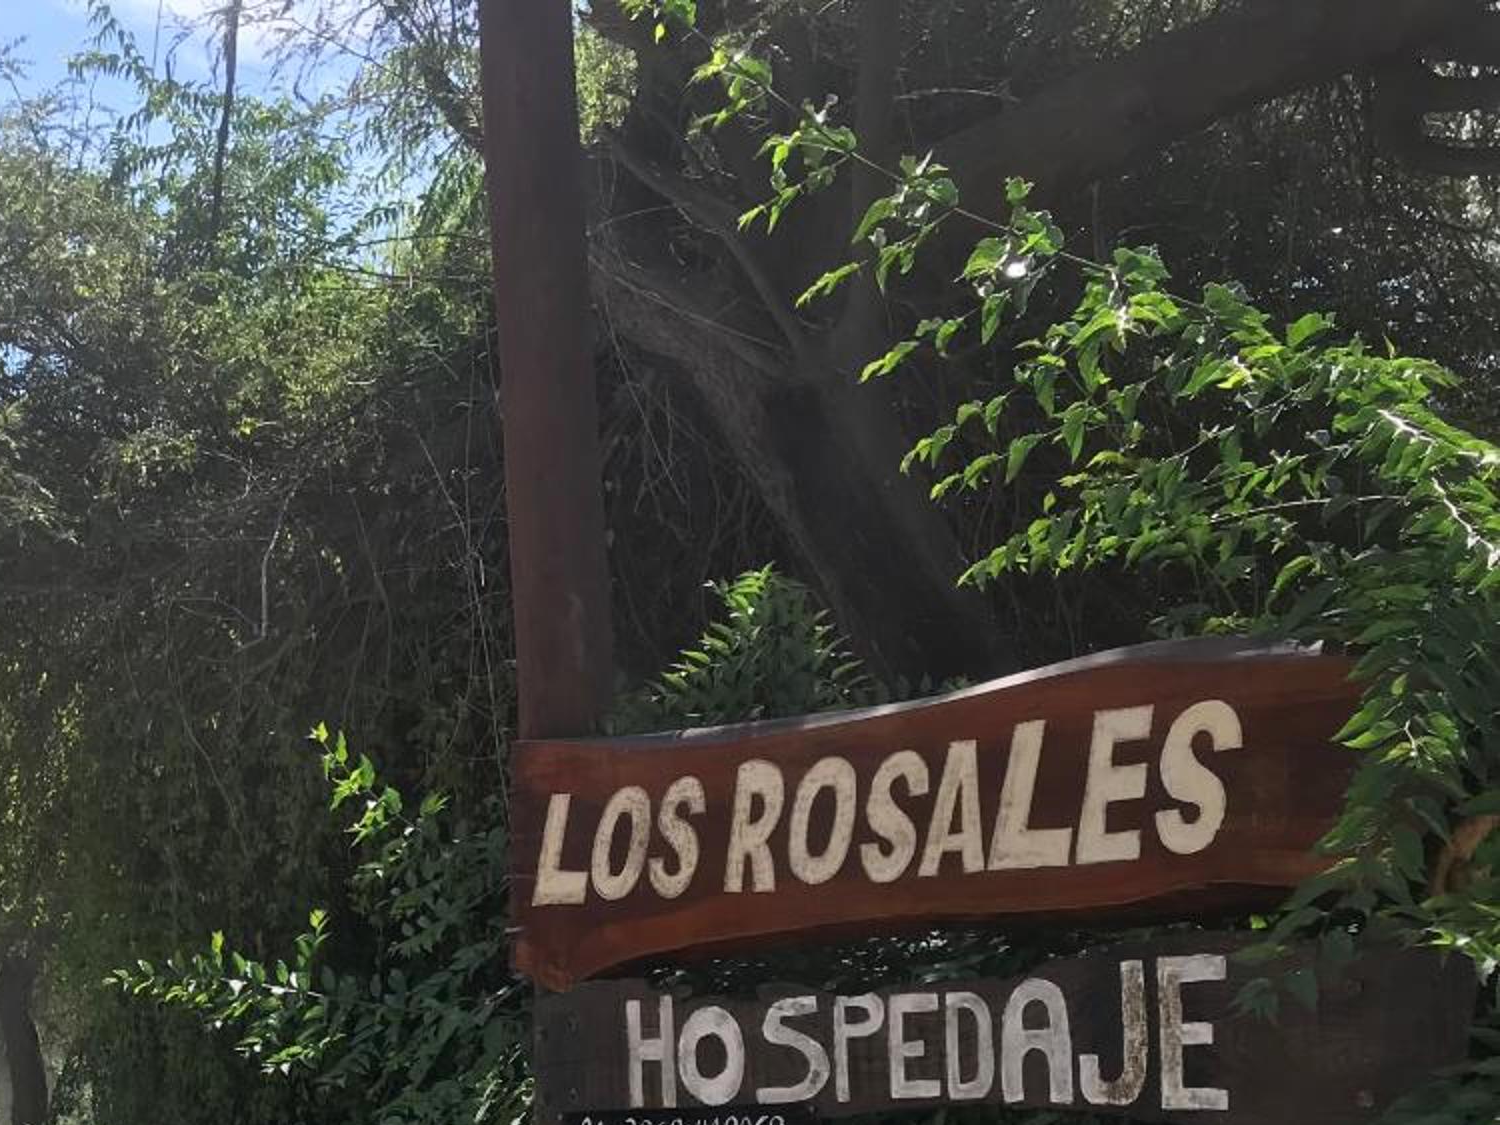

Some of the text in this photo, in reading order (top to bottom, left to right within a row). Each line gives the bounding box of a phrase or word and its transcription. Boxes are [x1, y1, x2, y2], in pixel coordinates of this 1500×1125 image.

[532, 699, 1244, 907] LOS ROSALES
[624, 953, 1230, 1113] HOSPEDAJE
